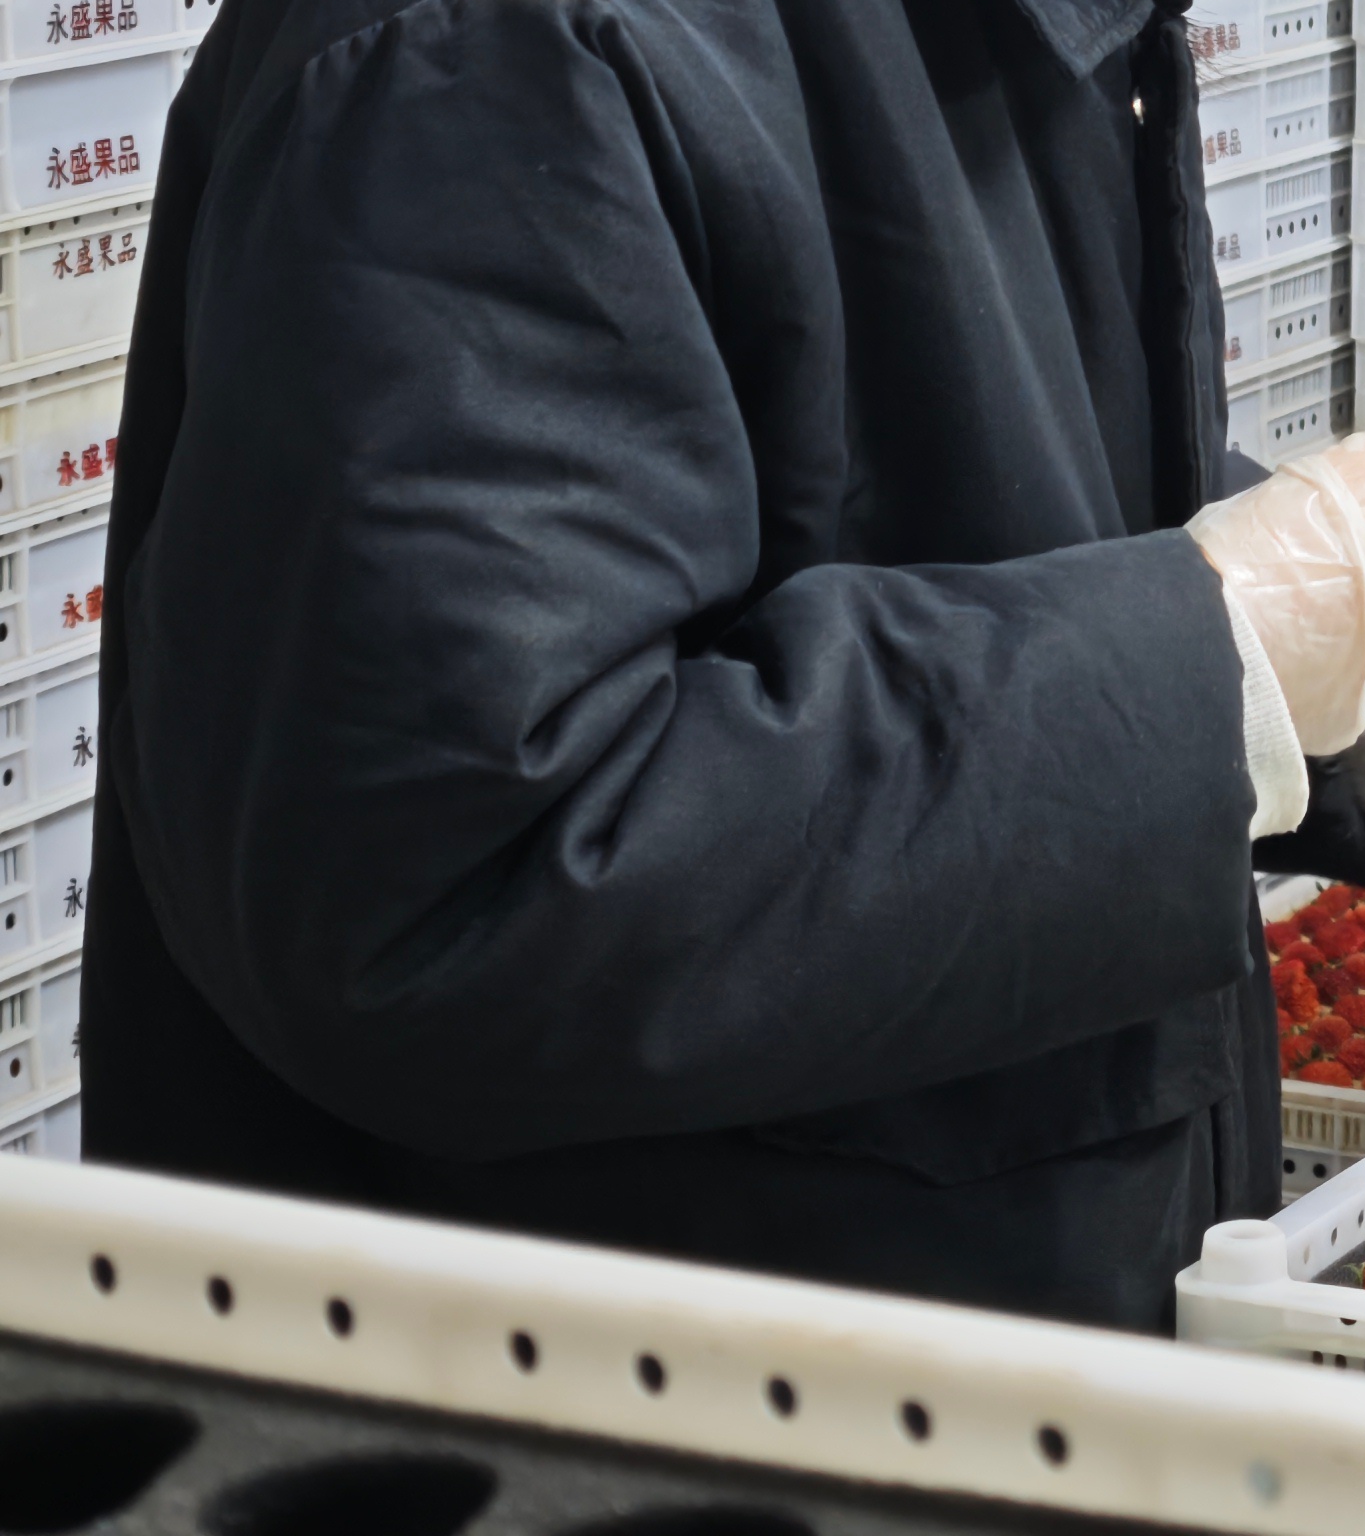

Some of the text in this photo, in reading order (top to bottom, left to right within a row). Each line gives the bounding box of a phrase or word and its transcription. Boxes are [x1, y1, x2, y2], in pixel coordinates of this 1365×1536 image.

[46, 134, 140, 190] 永盛果品
[52, 232, 137, 280] 永盛果品
